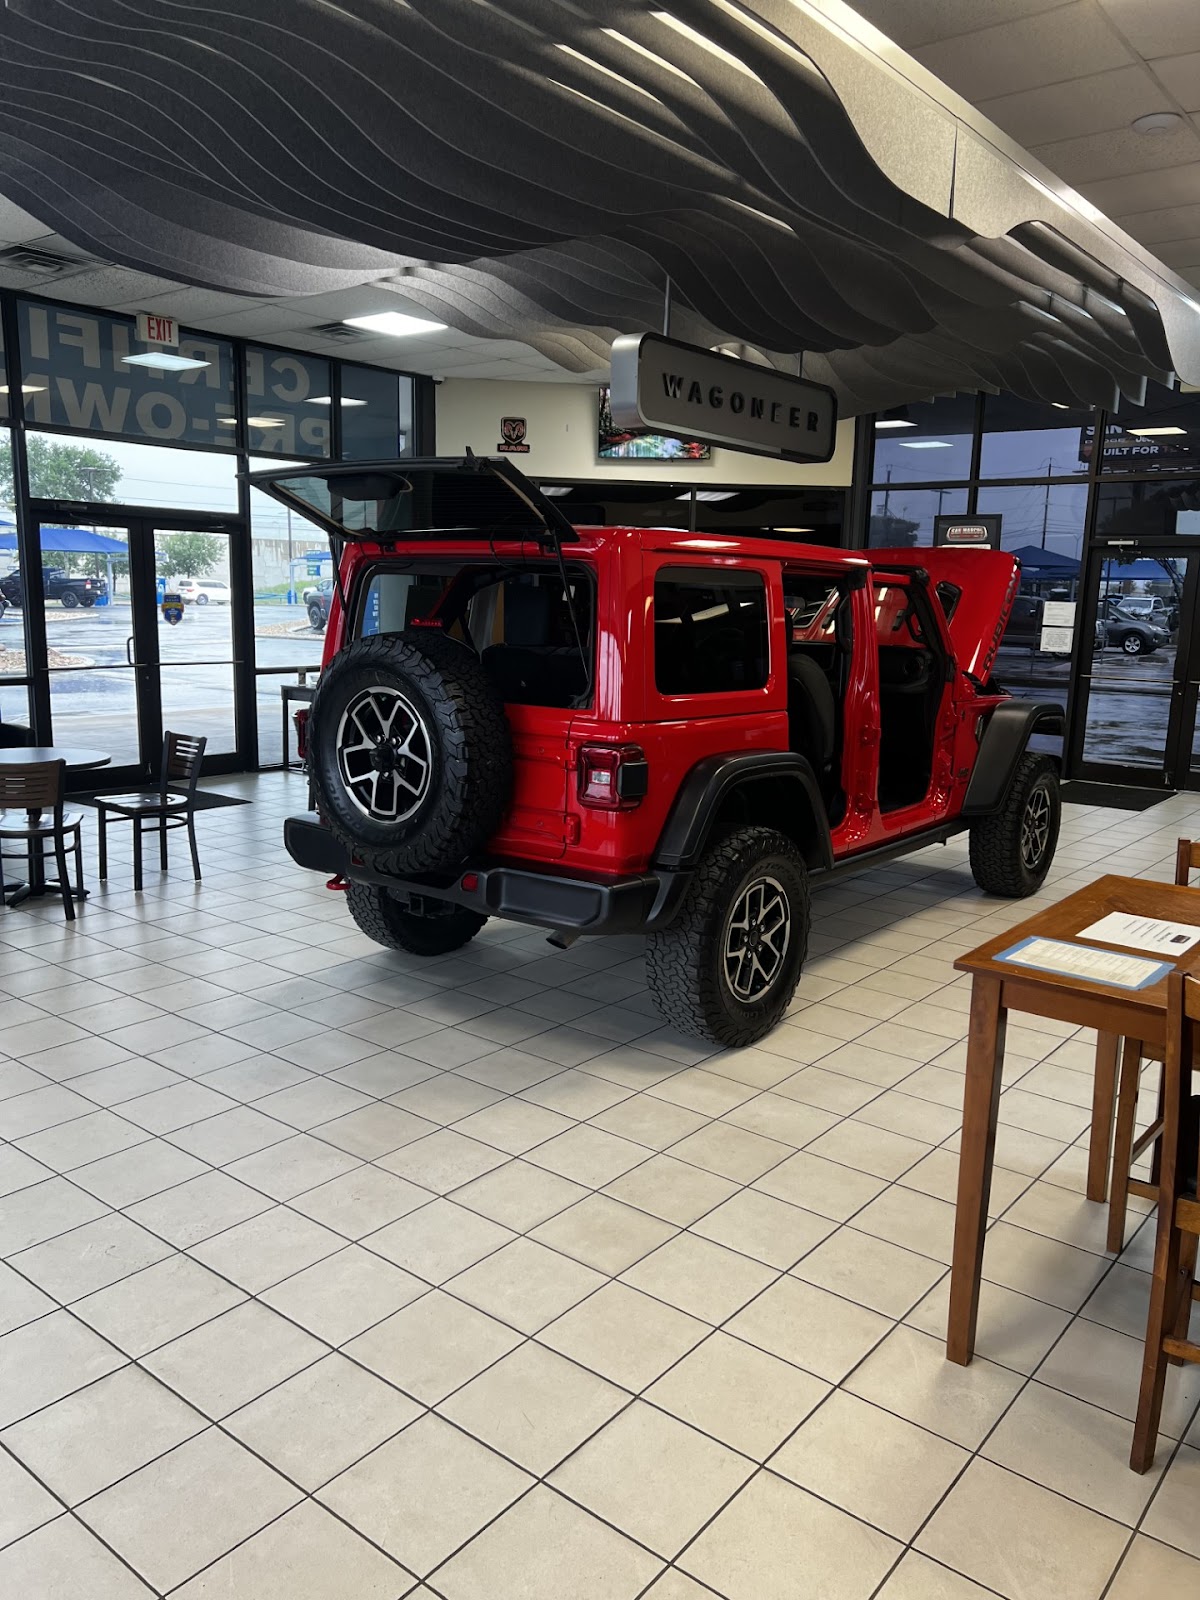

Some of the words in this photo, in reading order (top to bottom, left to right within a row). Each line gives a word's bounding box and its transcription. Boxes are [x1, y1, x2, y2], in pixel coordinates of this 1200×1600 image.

[147, 316, 173, 342] EXIT
[662, 372, 820, 433] WAGONEER
[499, 444, 529, 452] RAM
[1103, 447, 1131, 456] UILT
[1132, 445, 1160, 455] FOR
[984, 573, 1016, 671] RUBICON
